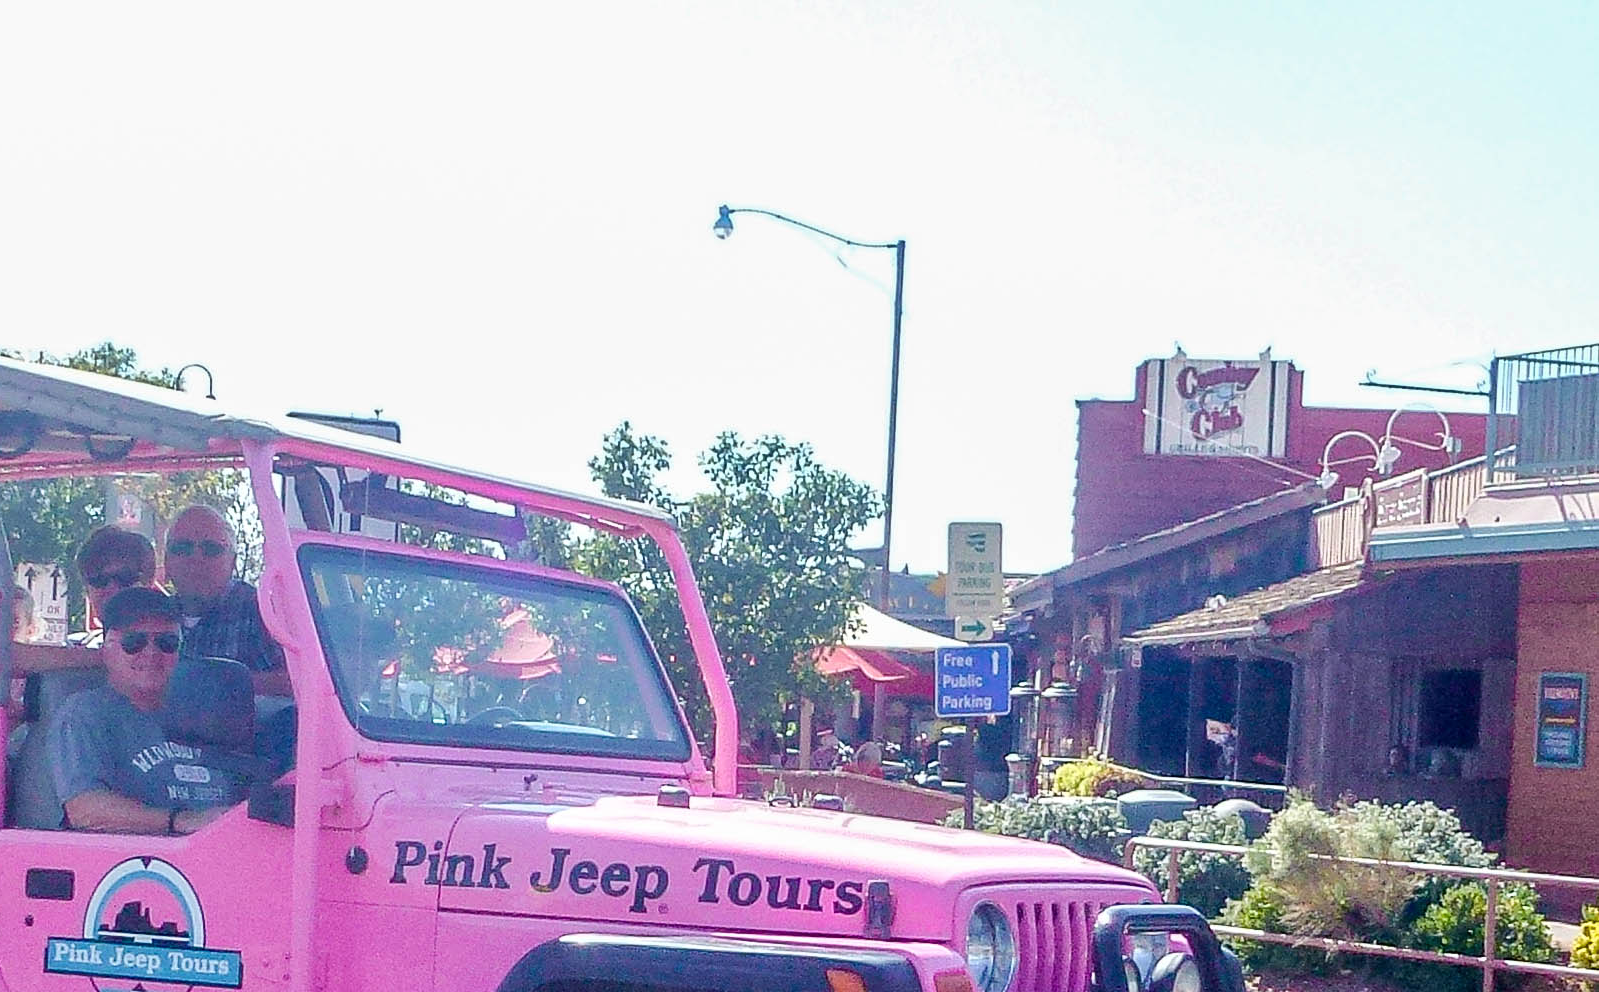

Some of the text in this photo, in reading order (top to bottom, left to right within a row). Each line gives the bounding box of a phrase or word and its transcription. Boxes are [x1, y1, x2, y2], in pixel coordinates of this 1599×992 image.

[943, 653, 972, 667] Free
[943, 674, 983, 689] Public
[943, 694, 992, 710] Parking
[389, 840, 864, 915] Pink Jeep Tours
[53, 942, 230, 975] Pink Jeep Tours
